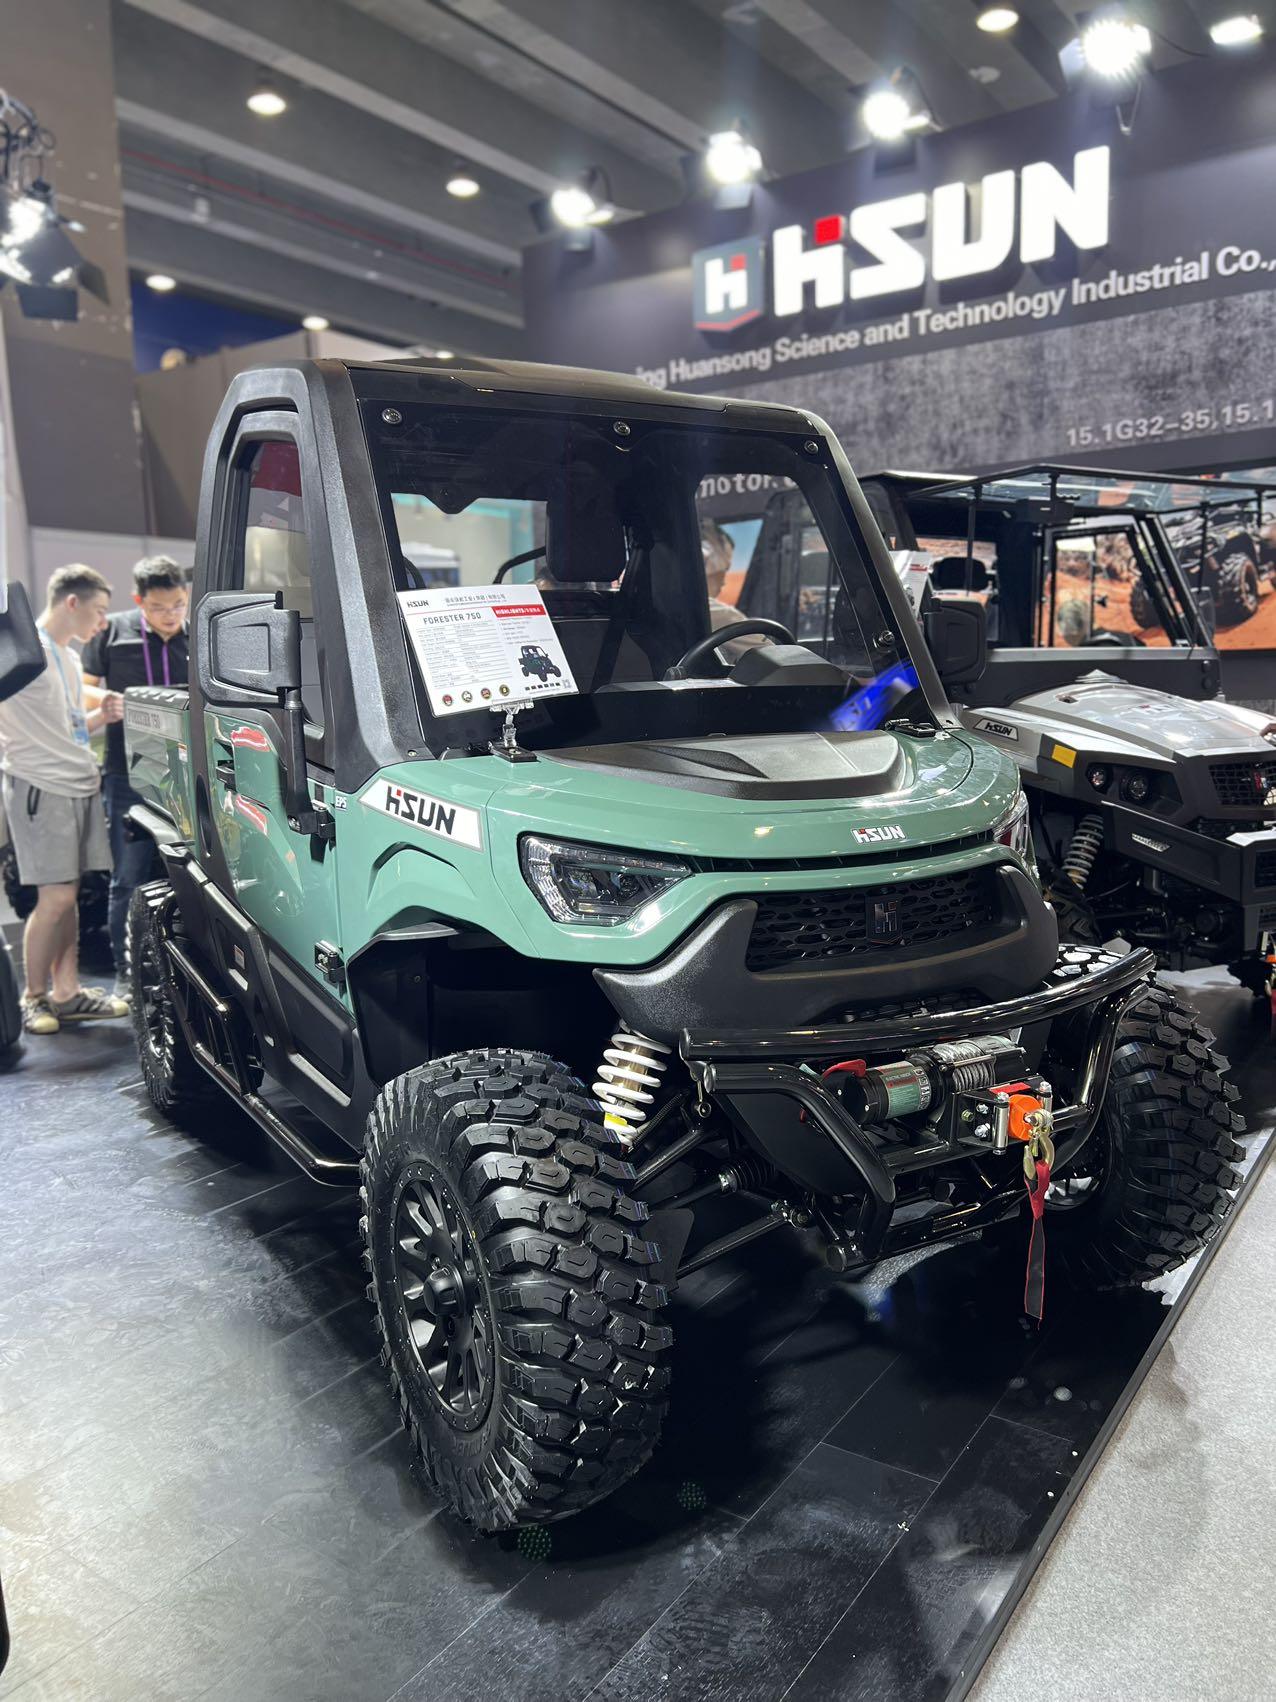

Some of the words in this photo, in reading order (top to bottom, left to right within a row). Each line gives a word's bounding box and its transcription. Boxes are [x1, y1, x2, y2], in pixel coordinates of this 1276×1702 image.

[636, 366, 667, 390] ing
[669, 347, 772, 384] Huansong
[775, 330, 860, 363] Science
[863, 313, 910, 346] and
[912, 287, 1066, 336] Technology
[1071, 251, 1209, 305] Industrial
[423, 614, 465, 625] FORESTER
[466, 612, 482, 621] 750
